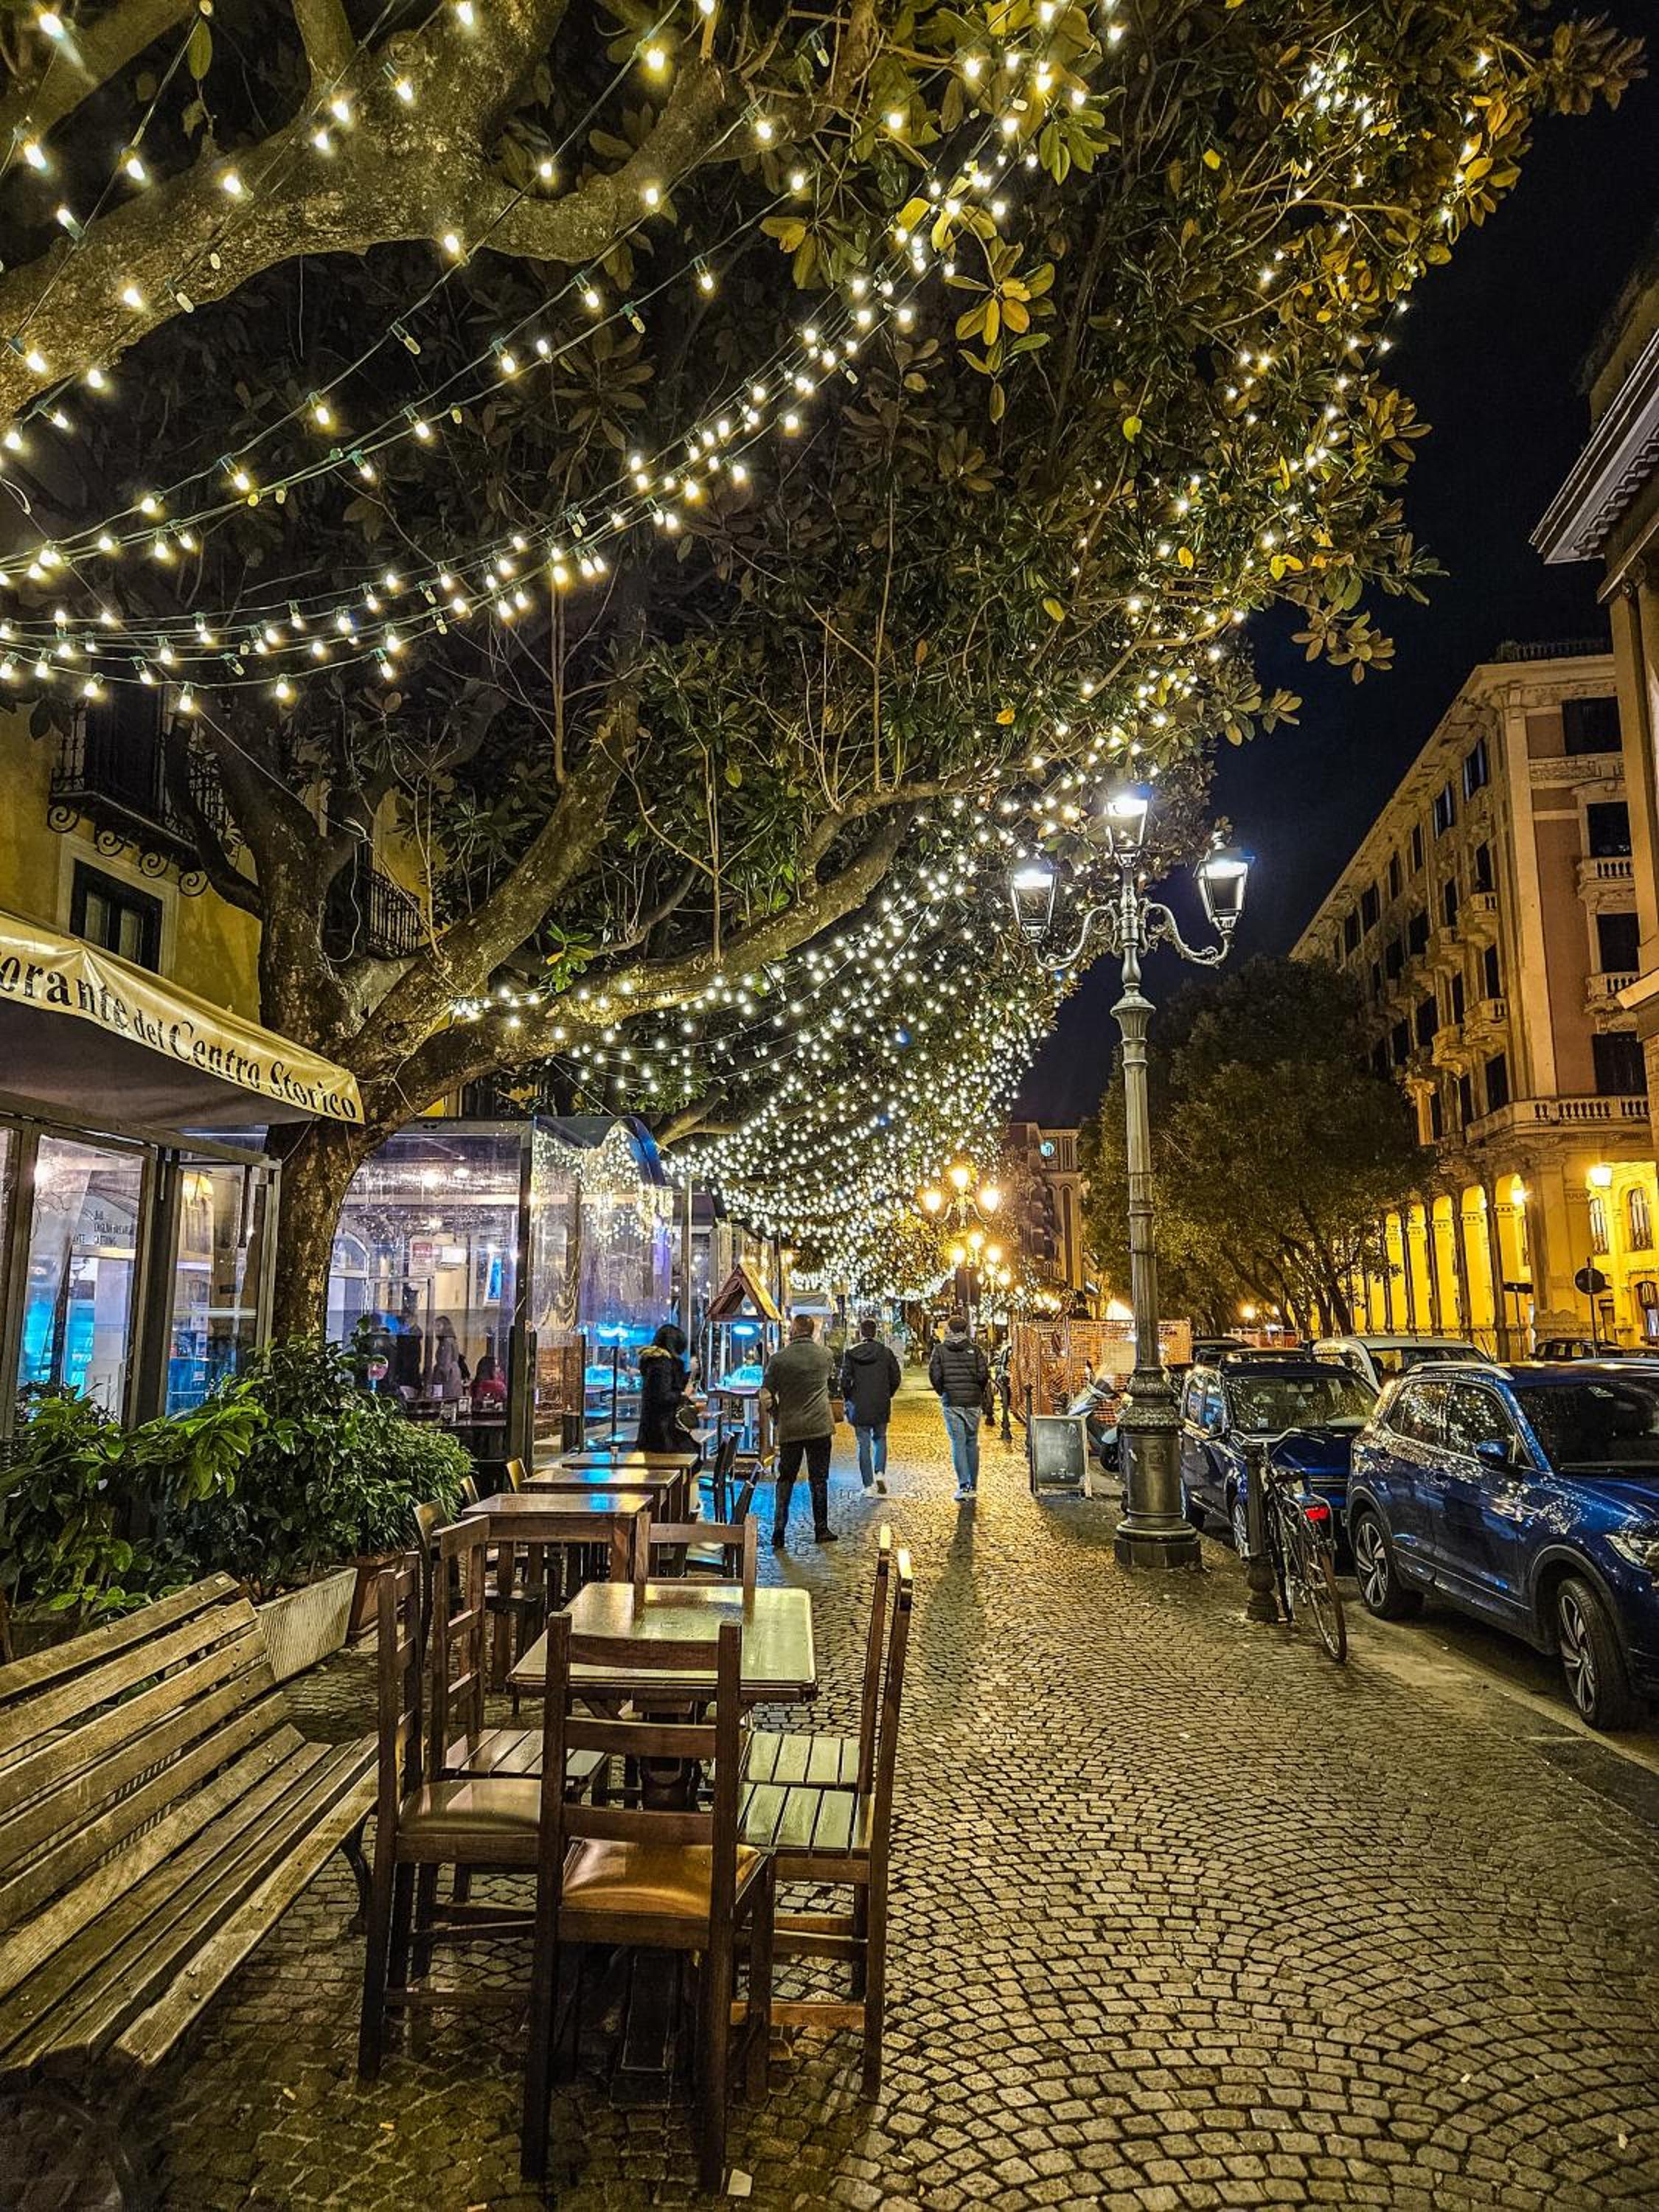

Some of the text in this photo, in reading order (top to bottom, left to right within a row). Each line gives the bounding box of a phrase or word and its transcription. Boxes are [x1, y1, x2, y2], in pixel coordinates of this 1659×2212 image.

[134, 1009, 164, 1049] del
[170, 1022, 260, 1088] Centro
[271, 1062, 356, 1119] Storico
